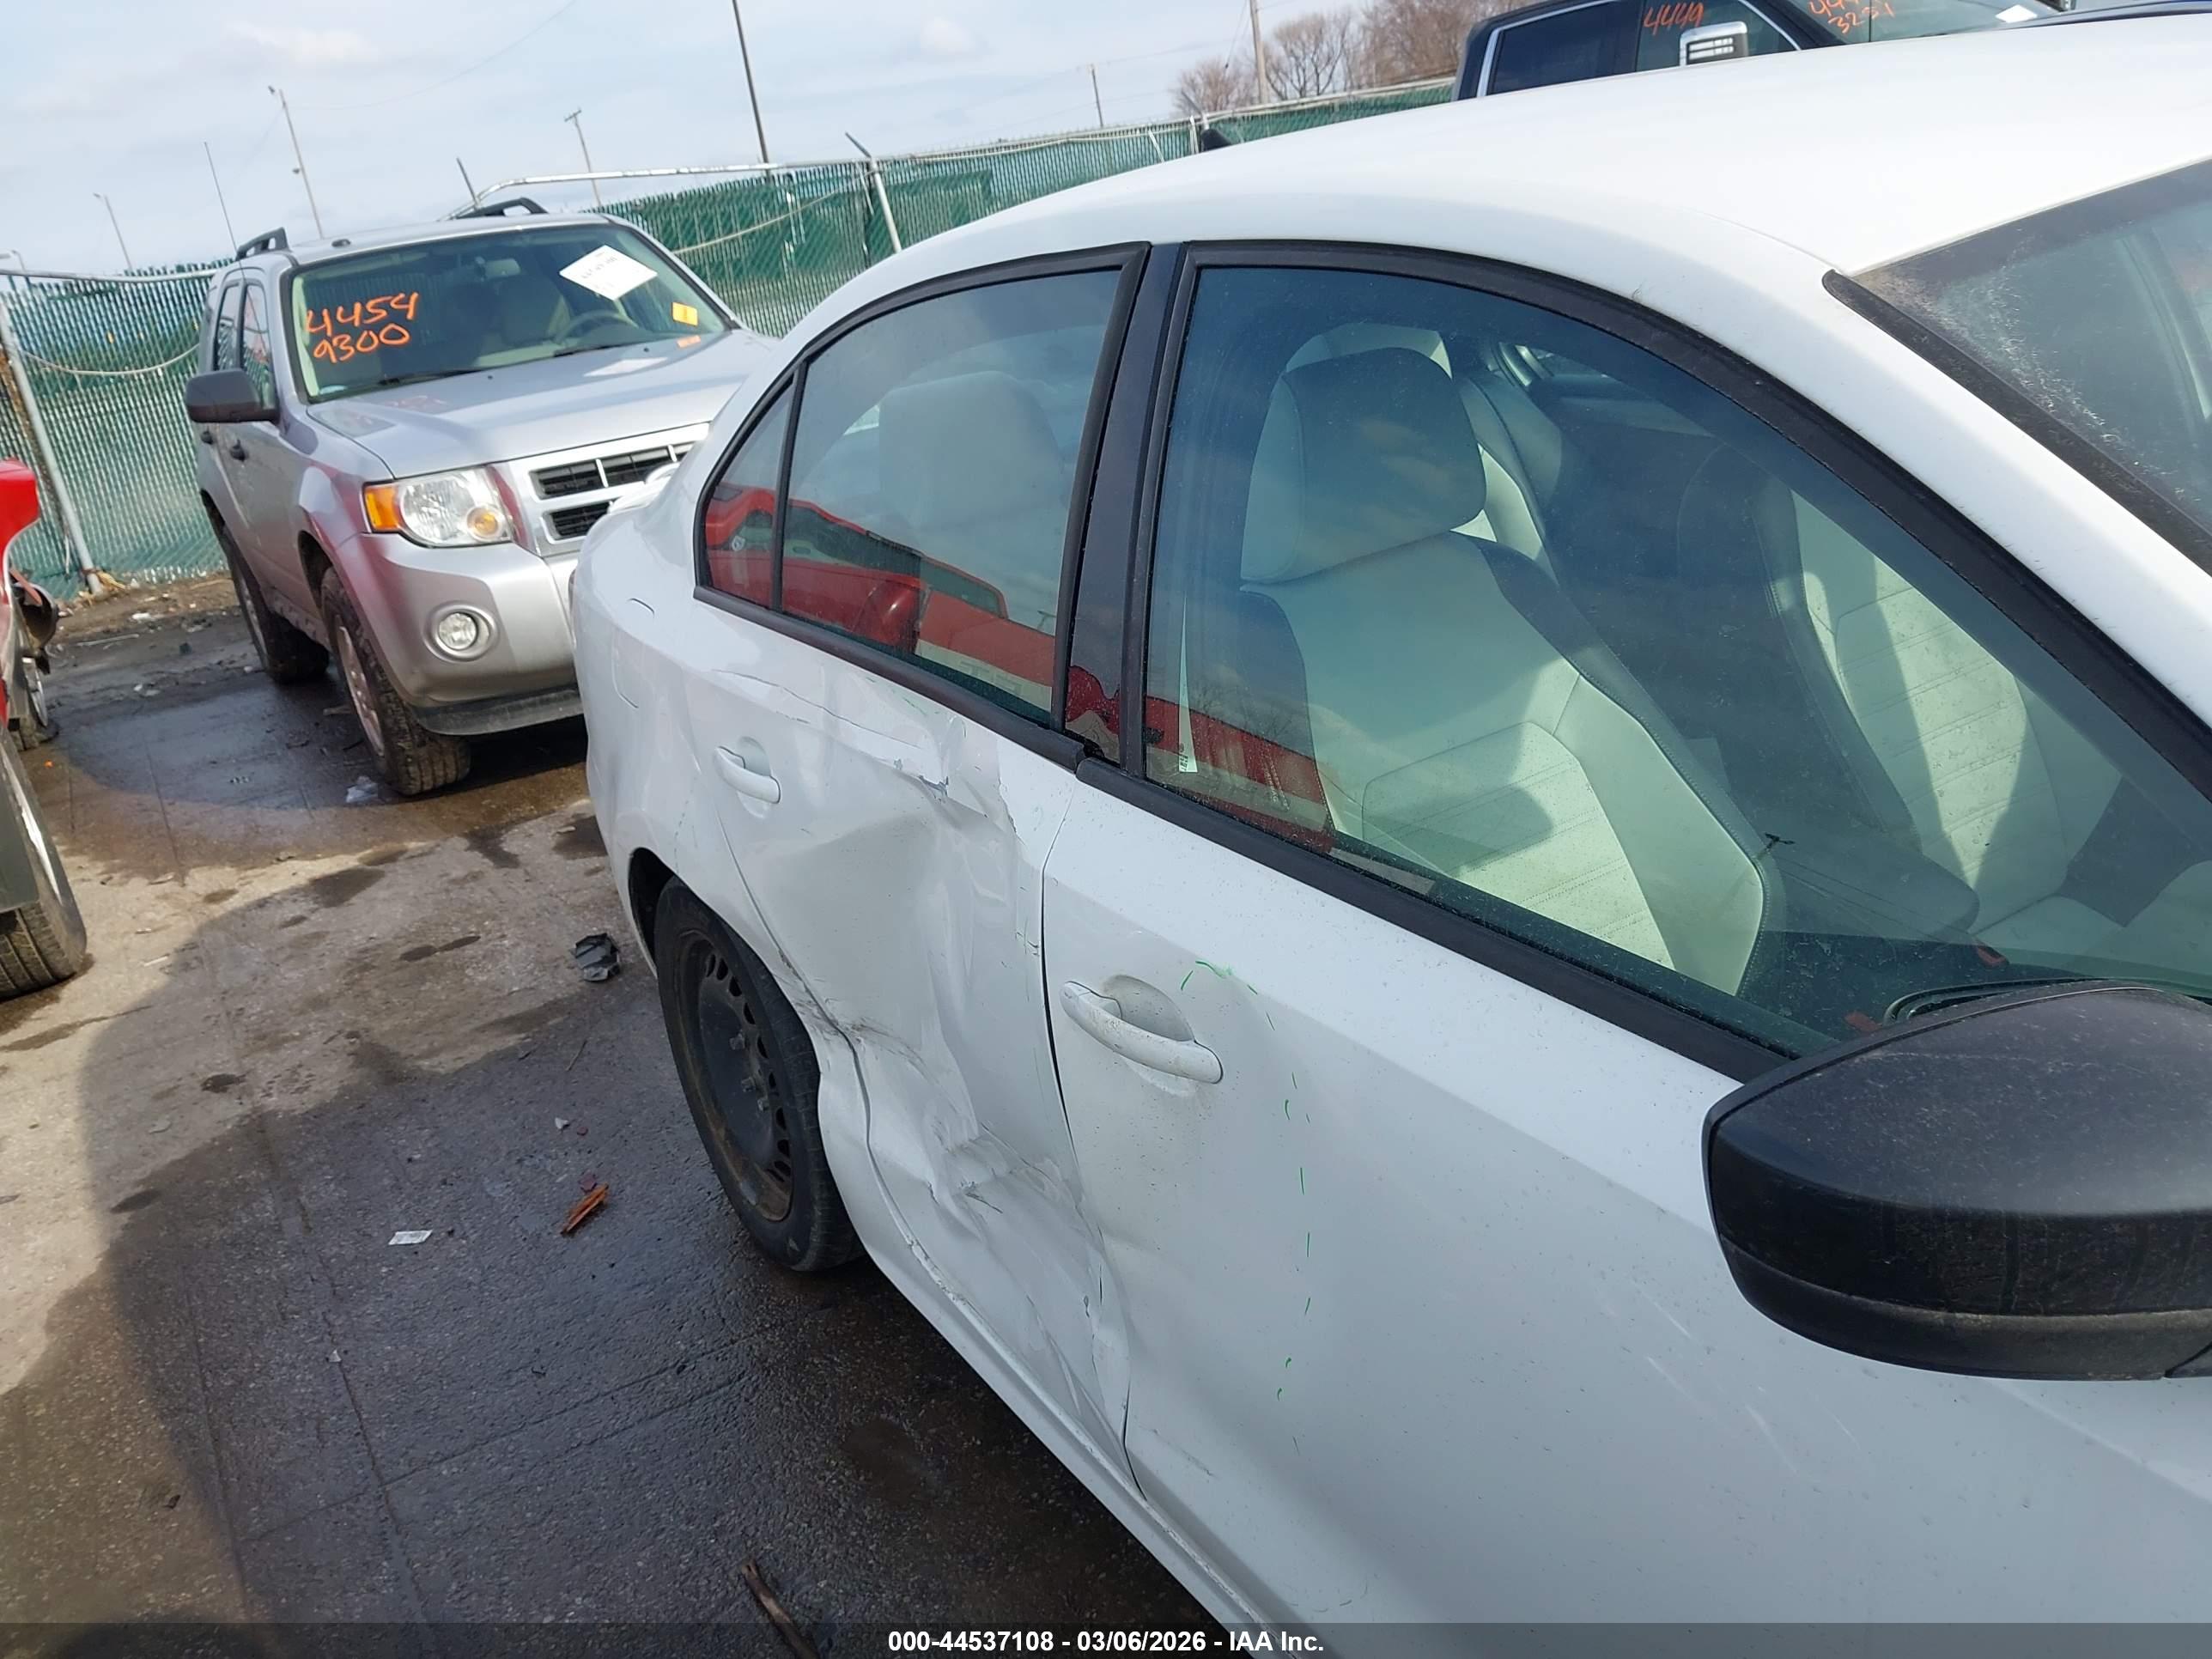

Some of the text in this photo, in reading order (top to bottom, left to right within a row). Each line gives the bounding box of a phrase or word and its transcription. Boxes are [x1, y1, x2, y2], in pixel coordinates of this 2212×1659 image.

[1644, 2, 1705, 36] 4449
[306, 292, 419, 337] 4454
[313, 323, 410, 363] 9300
